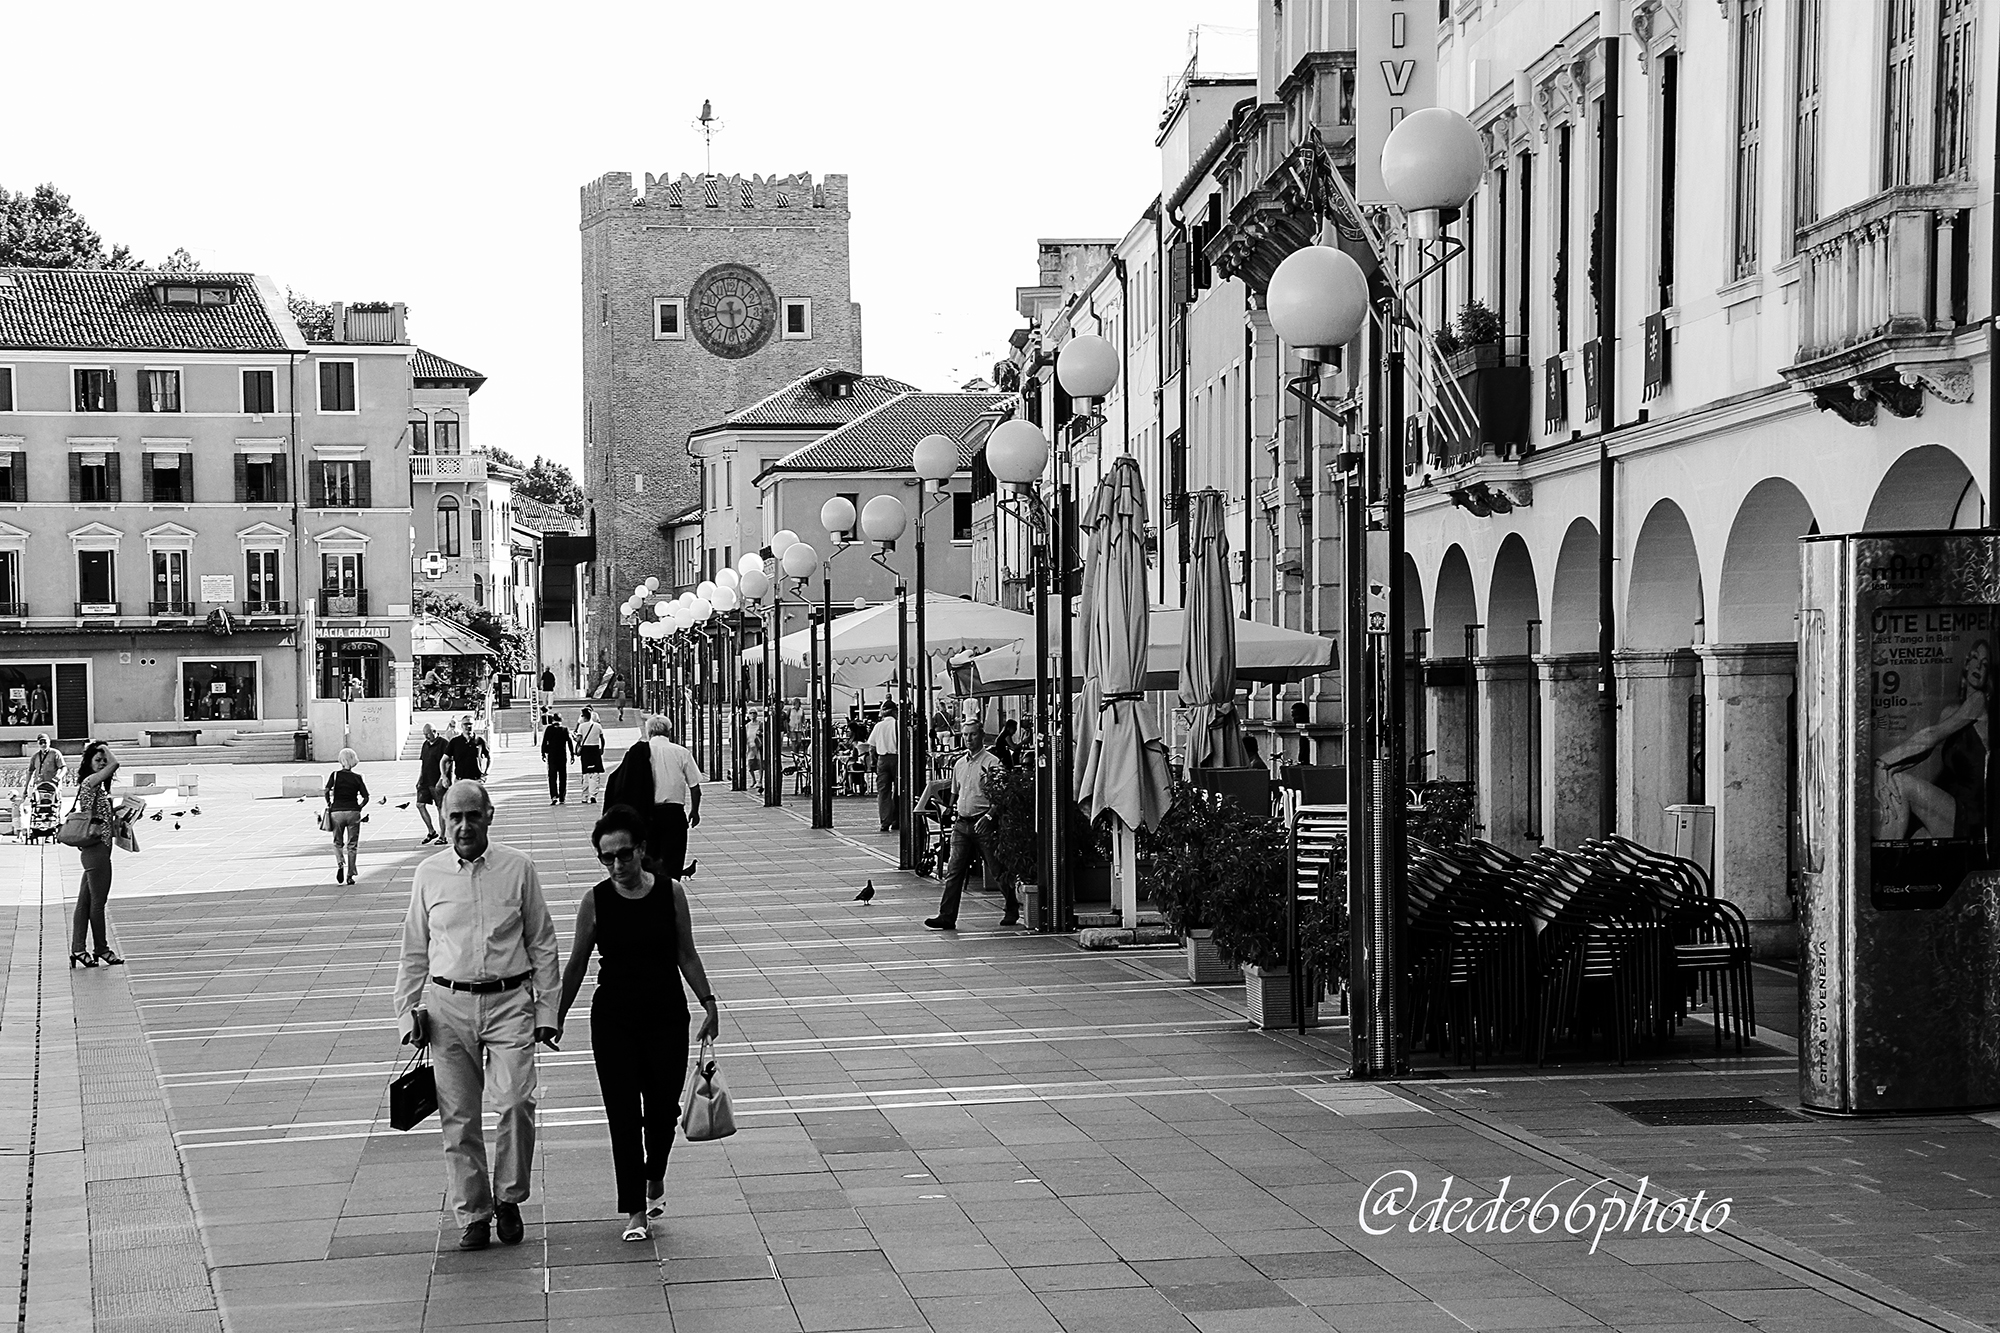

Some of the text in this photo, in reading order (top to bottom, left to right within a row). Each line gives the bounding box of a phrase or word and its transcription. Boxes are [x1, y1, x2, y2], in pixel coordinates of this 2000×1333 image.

[716, 285, 724, 296] 11
[726, 281, 736, 292] 12
[706, 294, 716, 305] 10
[748, 293, 756, 304] 2
[753, 306, 760, 318] 3
[707, 319, 714, 331] 8
[717, 328, 723, 340] 7
[740, 328, 747, 339] 5
[1871, 614, 1918, 634] UTE
[315, 627, 389, 638] MACIA GRAZIATI
[1894, 635, 1923, 645] Tango
[1926, 633, 1934, 642] in
[1936, 633, 1960, 642] Berlin
[1889, 646, 1944, 659] VENEZIA
[1890, 658, 1919, 666] TEATRO
[1930, 657, 1954, 665] FENICE
[1871, 670, 1900, 694] 19
[1871, 695, 1908, 709] luglio
[1818, 940, 1828, 1011] VENEZIA
[1819, 1016, 1828, 1033] DI
